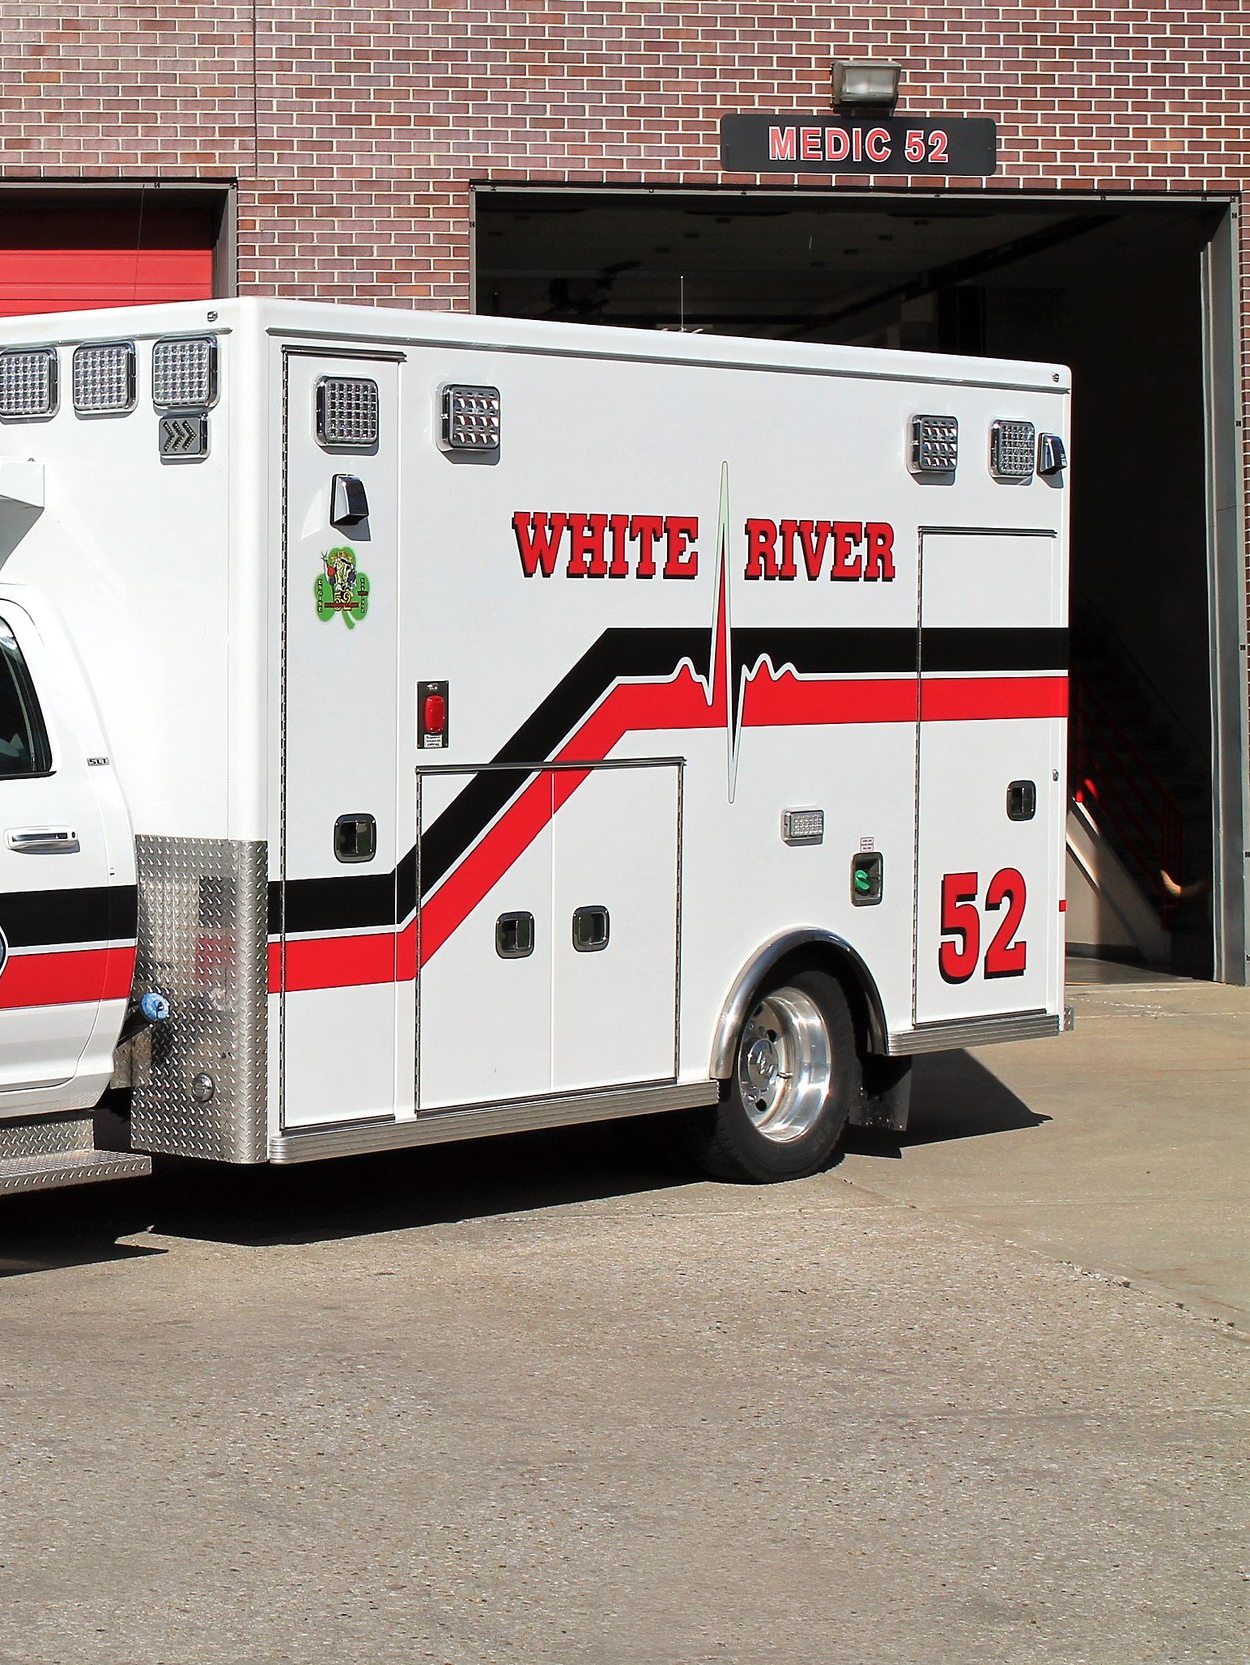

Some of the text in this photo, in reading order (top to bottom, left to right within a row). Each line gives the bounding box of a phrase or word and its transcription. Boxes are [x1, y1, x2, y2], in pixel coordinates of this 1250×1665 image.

[768, 126, 949, 163] MEDIC 52
[512, 511, 896, 582] WHITE RIVER
[938, 867, 1027, 985] 52
